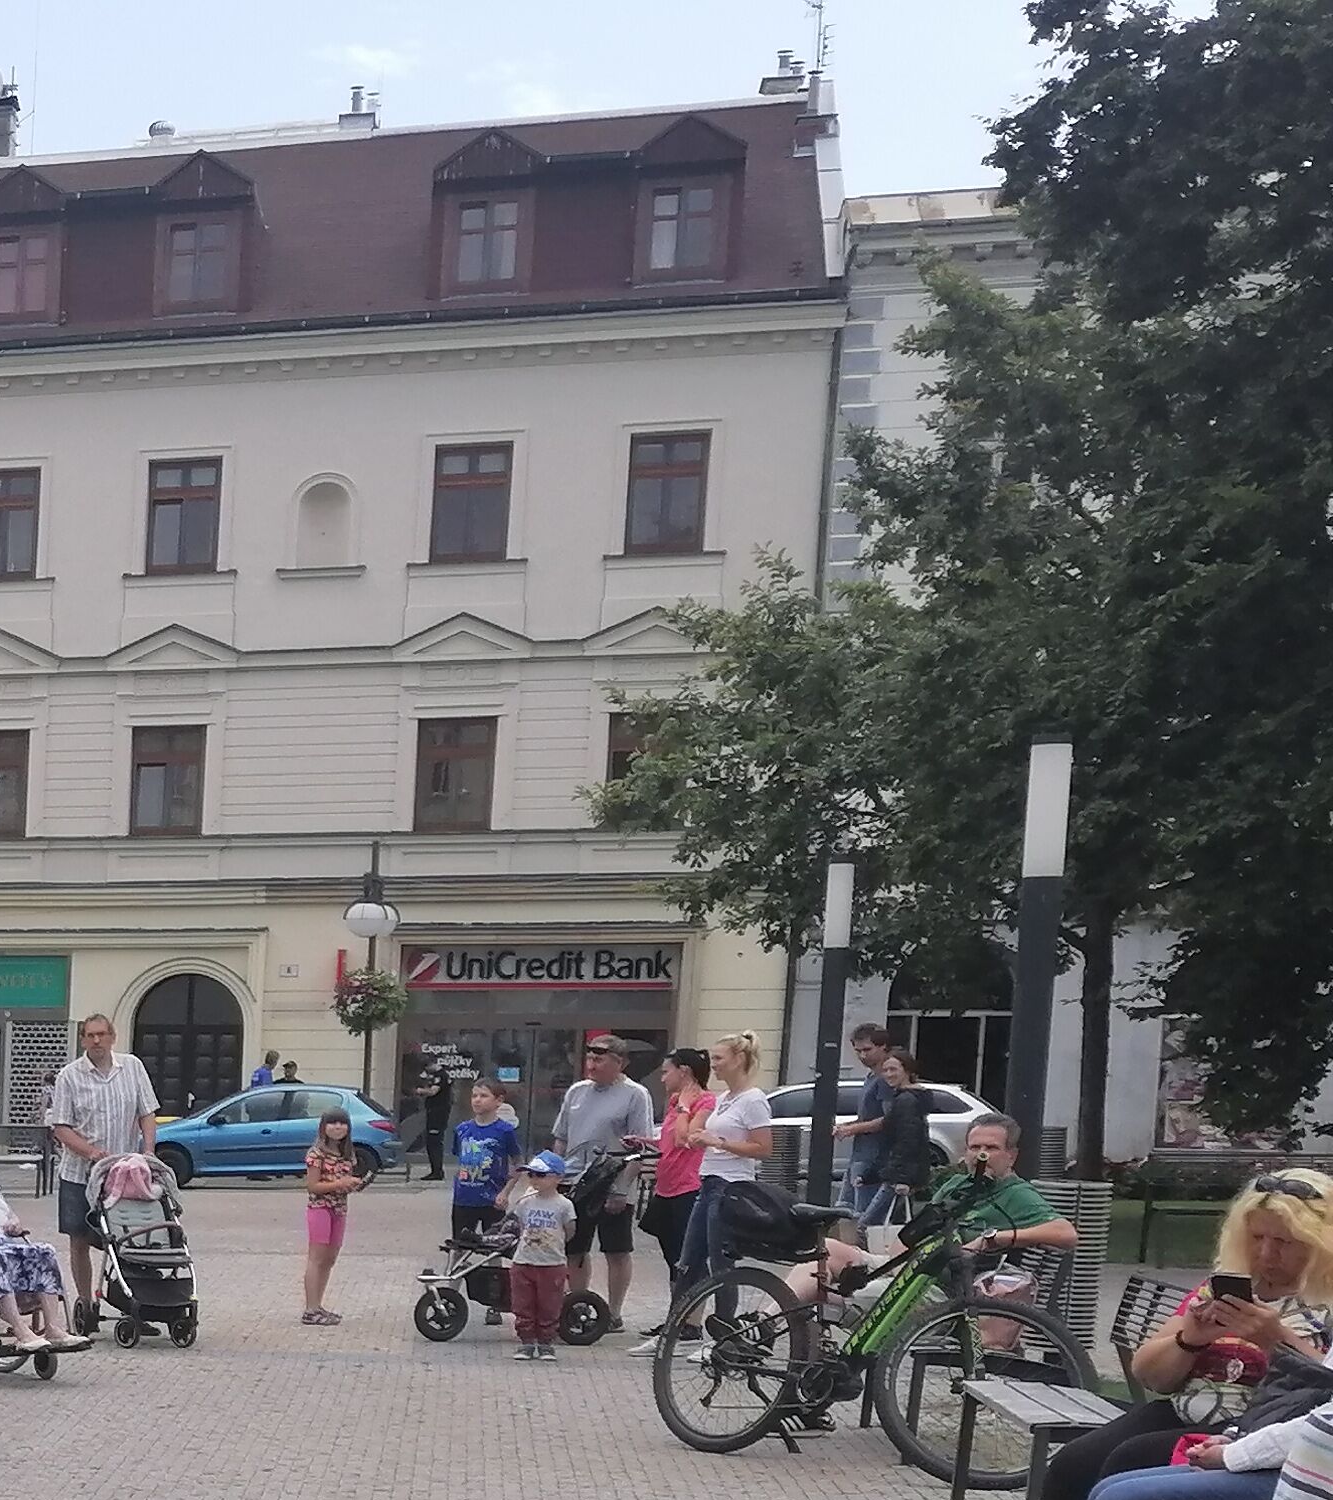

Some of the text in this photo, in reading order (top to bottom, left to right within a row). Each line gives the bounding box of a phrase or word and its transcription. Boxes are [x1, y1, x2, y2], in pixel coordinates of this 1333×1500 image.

[446, 949, 673, 980] UniCredit Bank
[421, 1042, 458, 1055] Expert
